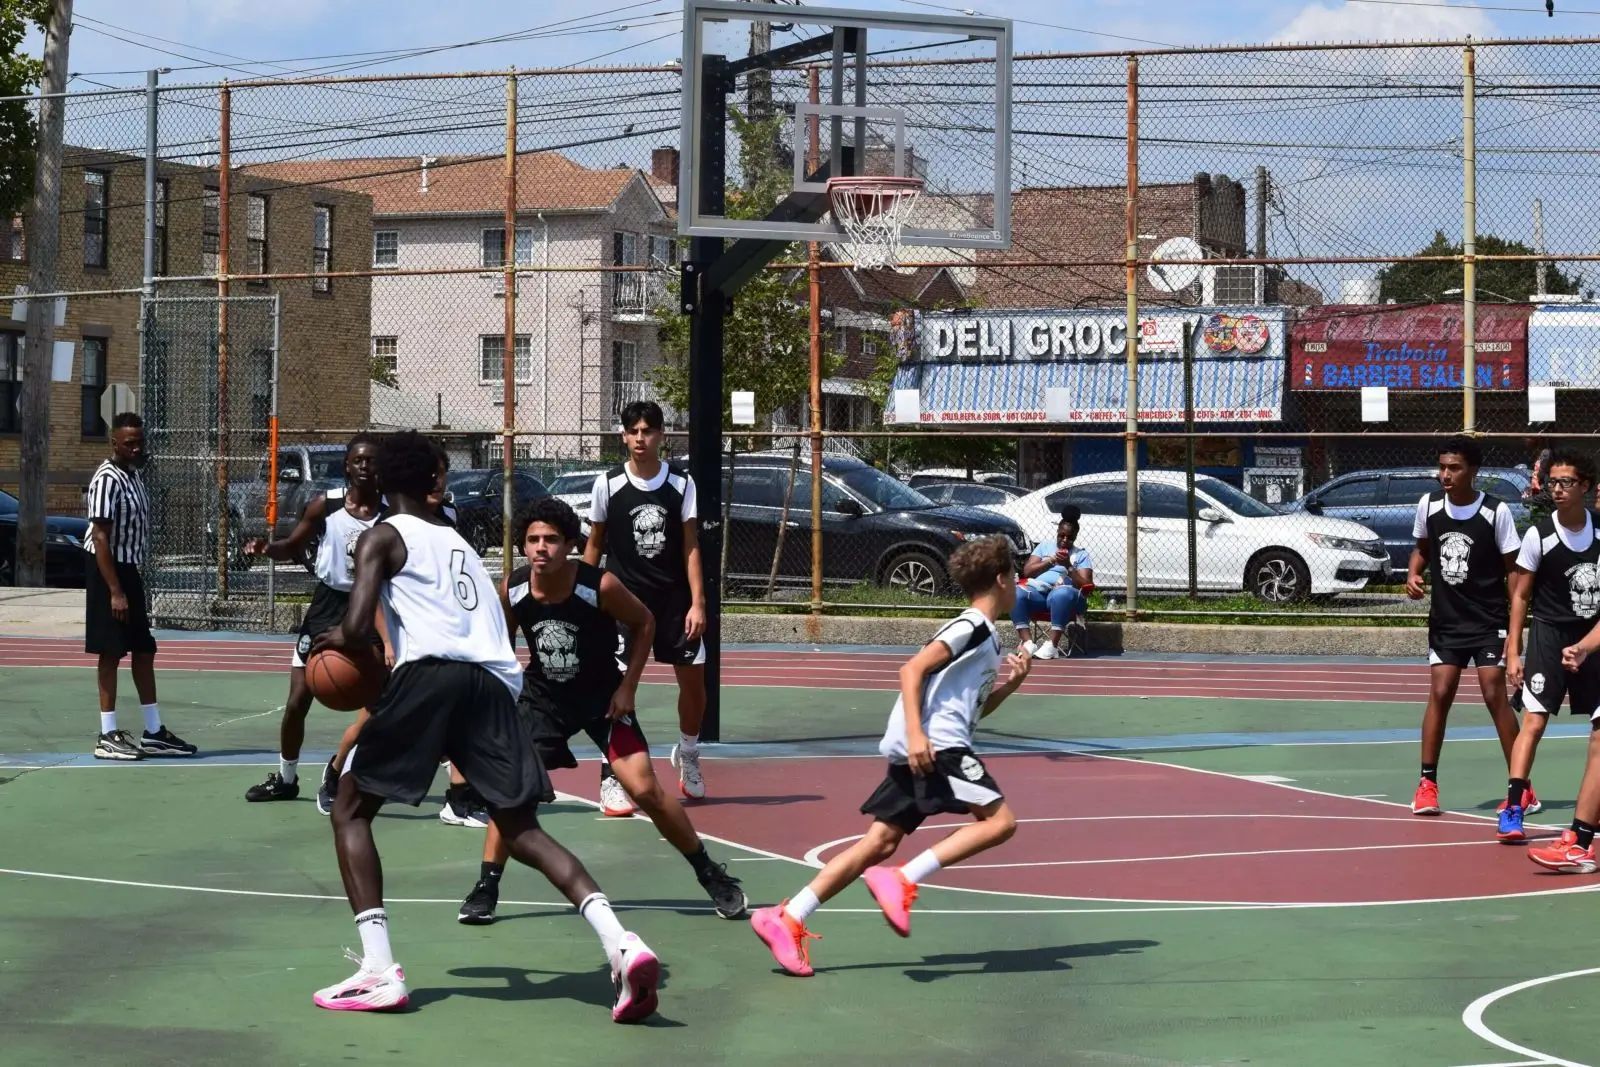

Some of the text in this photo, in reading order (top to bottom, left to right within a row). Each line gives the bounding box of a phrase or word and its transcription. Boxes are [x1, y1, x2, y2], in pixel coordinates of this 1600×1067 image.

[933, 319, 1011, 357] DELI
[1025, 317, 1201, 357] GROC
[1323, 364, 1492, 388] BARBER SALN
[1006, 412, 1019, 421] HOT
[1090, 411, 1113, 420] COFFEE
[1220, 410, 1235, 419] ATM
[1275, 455, 1299, 467] ICE
[450, 549, 479, 612] 6
